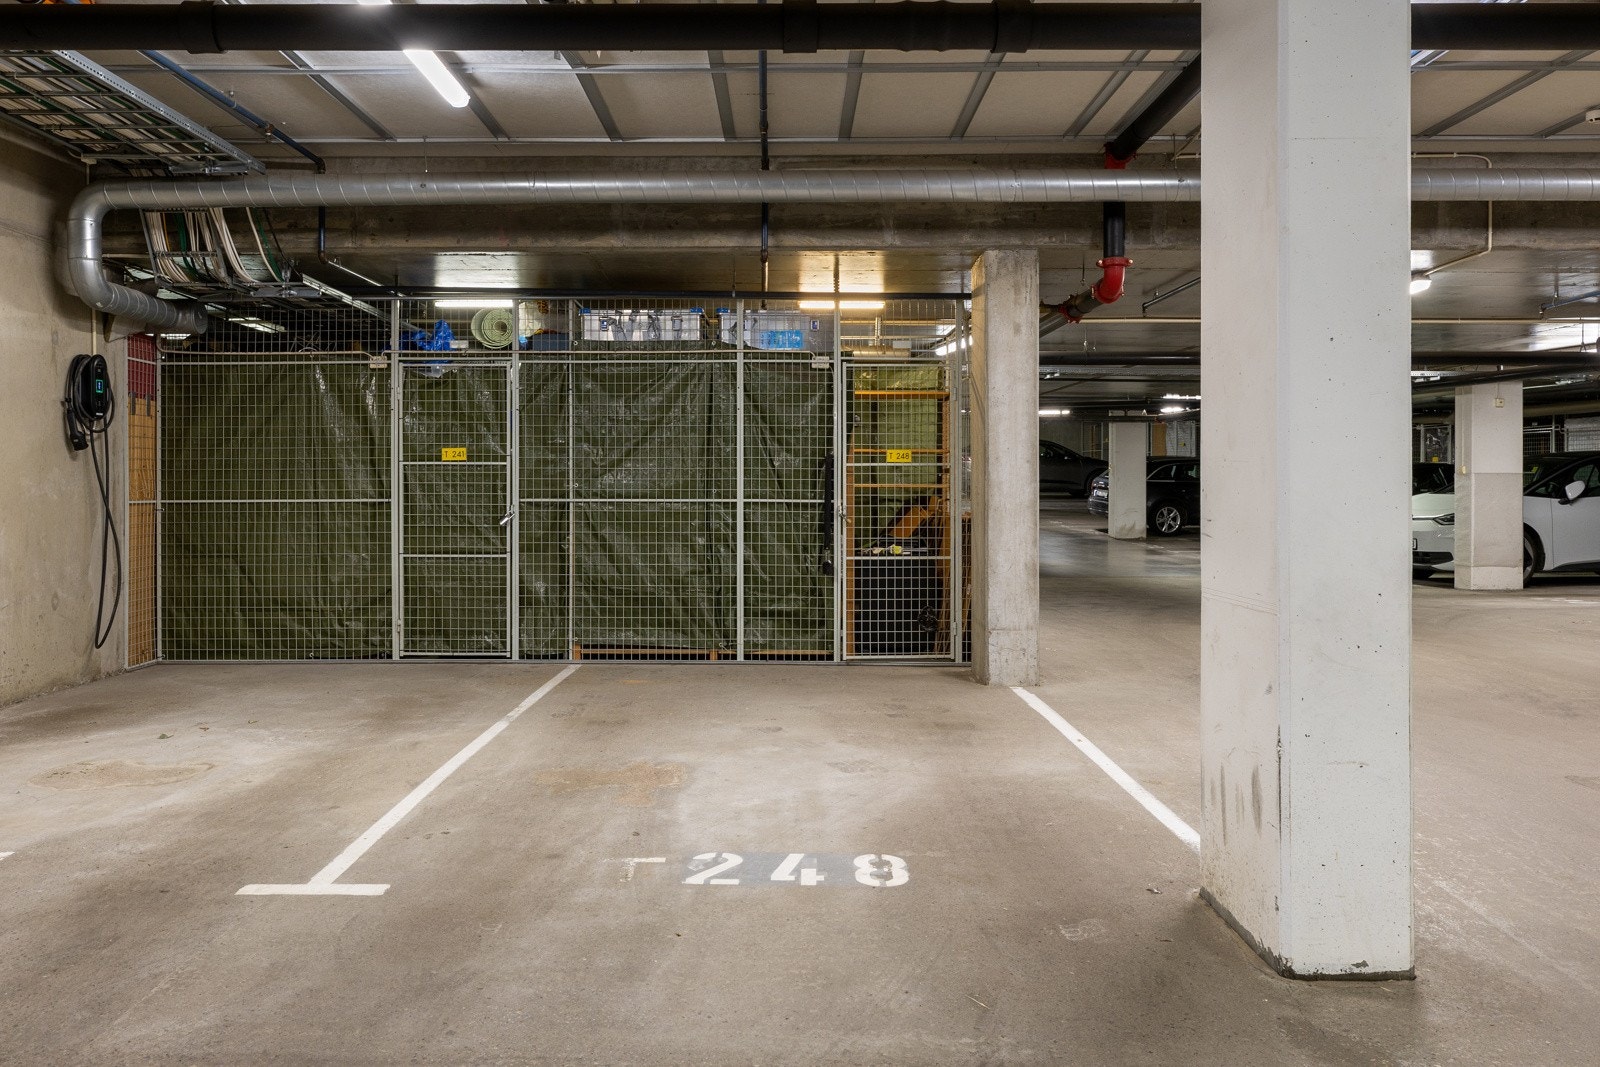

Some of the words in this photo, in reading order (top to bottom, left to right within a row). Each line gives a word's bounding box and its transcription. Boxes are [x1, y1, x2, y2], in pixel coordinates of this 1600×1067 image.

[452, 450, 465, 458] 241
[896, 452, 910, 460] 248
[682, 852, 910, 887] 248
